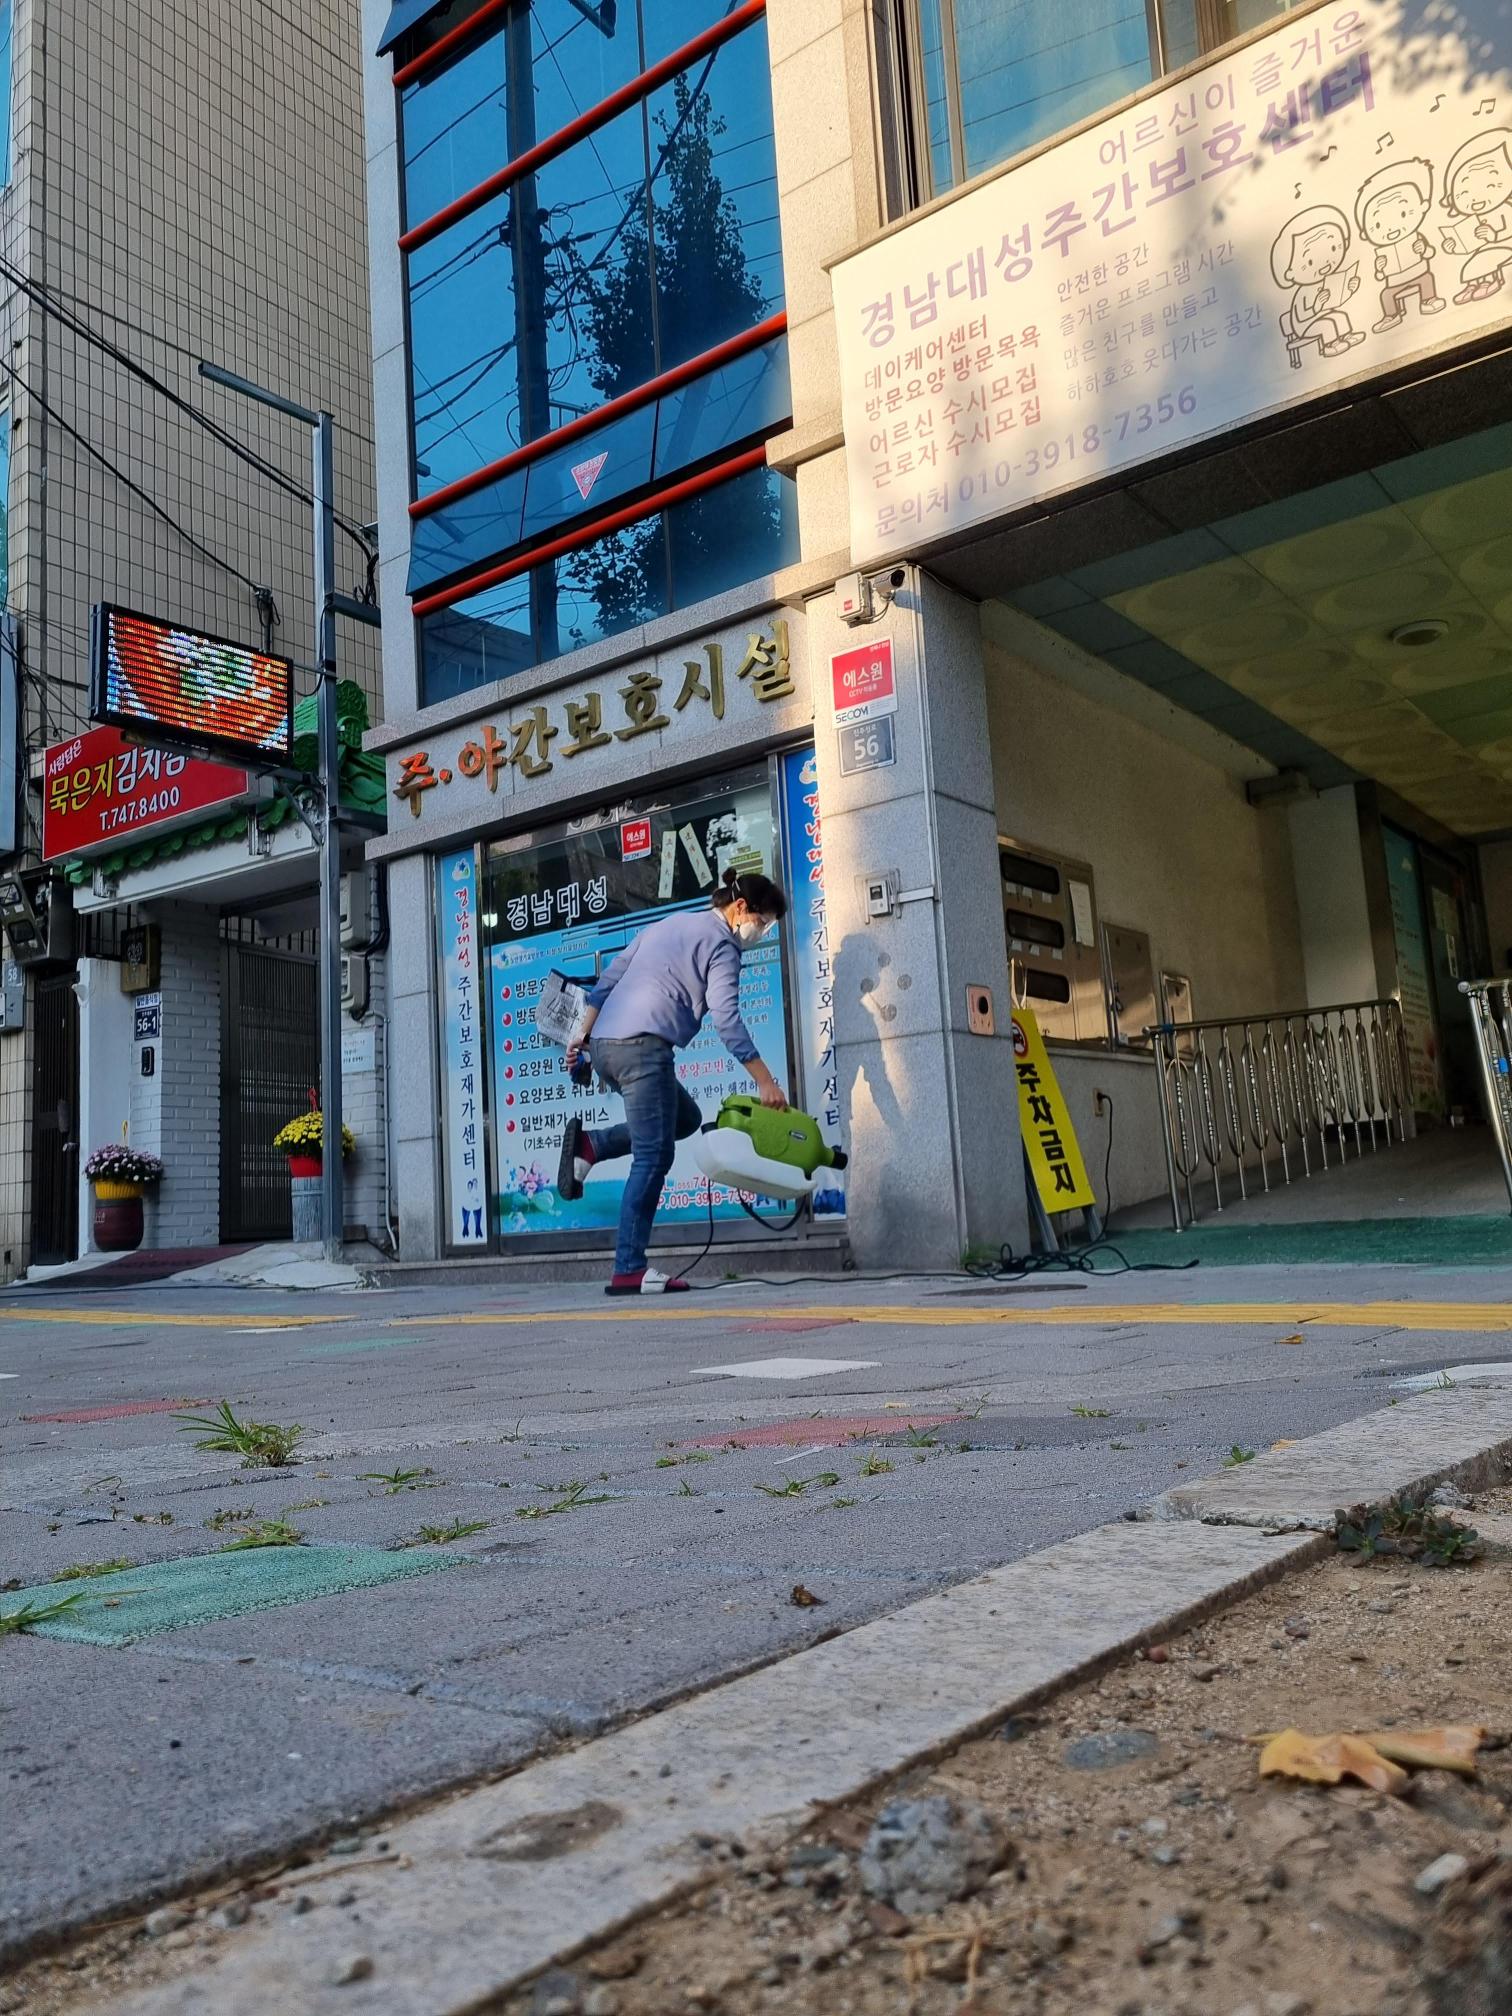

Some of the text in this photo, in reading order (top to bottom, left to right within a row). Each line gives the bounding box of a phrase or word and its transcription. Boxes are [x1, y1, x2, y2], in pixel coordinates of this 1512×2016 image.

[1099, 10, 1366, 166] 어르신이 즐거운
[1057, 242, 1149, 303] 안전한 공간
[1059, 240, 1235, 337] 즐거운 프로그램 시간
[865, 314, 988, 390] 데이케어센터
[1064, 286, 1220, 370] 많은 친구를 만들고
[1067, 304, 1263, 401] 하하호호 웃다가는 공간
[865, 325, 1041, 422] 방문요양 방문목욕
[870, 363, 1038, 455] 어르신 수시모집
[873, 396, 1041, 489] 근로자 수시모집
[875, 384, 1197, 538] 문의처 010-3918-7356
[843, 661, 884, 689] 에스원
[849, 688, 863, 698] CCTV
[836, 706, 868, 723] SECOM
[855, 735, 879, 761] 56
[100, 786, 180, 831] T.747.8400
[507, 876, 608, 931] 경남대성
[137, 1015, 156, 1033] 56-1
[518, 1057, 553, 1078] 요양원
[519, 1084, 567, 1105] 요양보호
[520, 1111, 568, 1133] 일반재가
[523, 1134, 565, 1152] (기초수급
[1015, 1063, 1077, 1194] 주차금지
